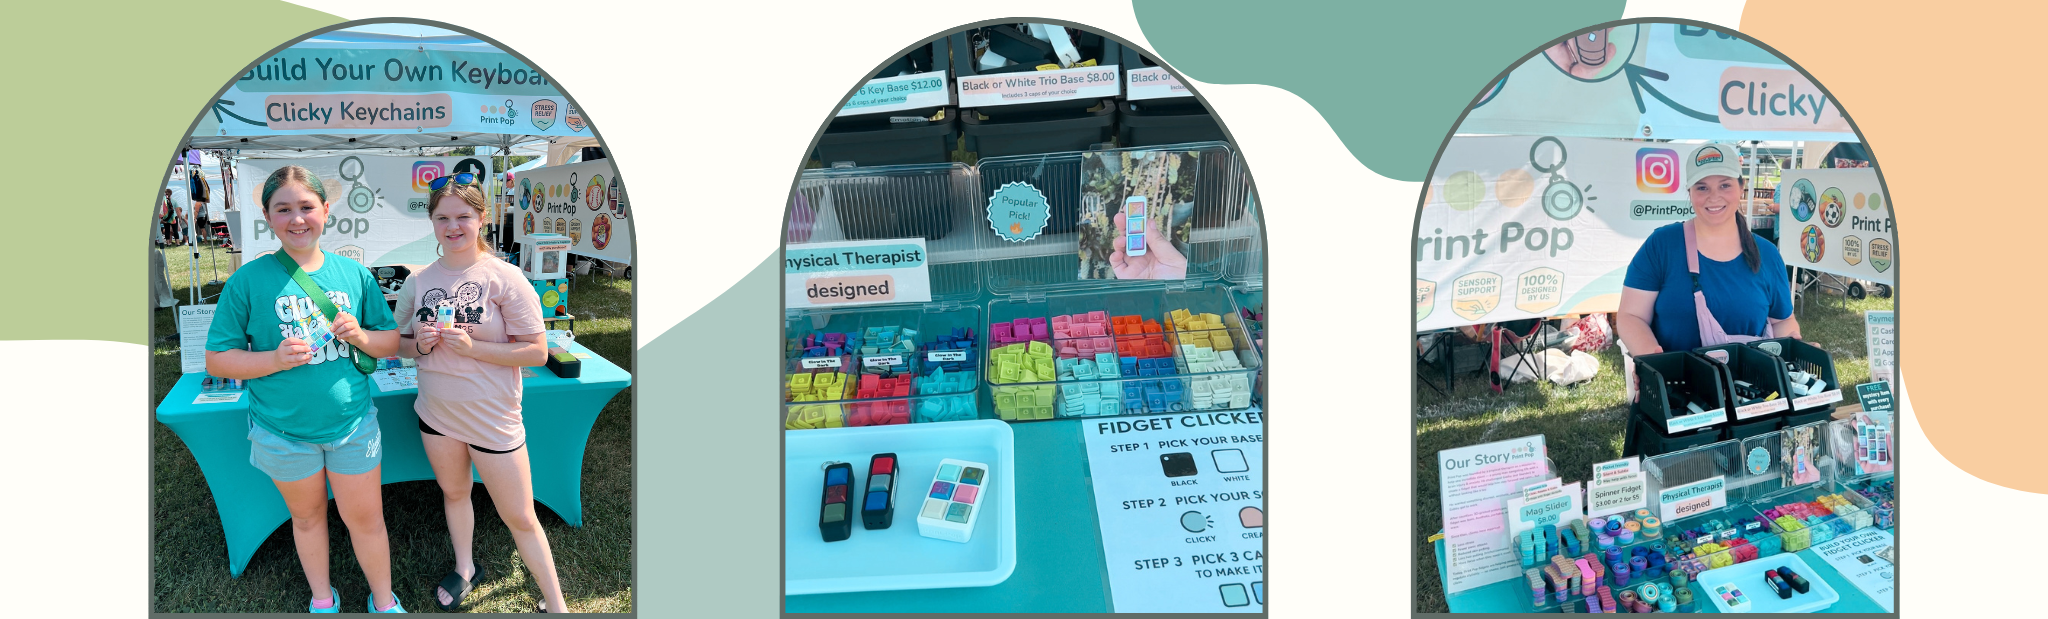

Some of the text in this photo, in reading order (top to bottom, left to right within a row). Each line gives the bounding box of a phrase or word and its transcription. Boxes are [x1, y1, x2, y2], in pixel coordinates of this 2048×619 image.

[315, 57, 376, 81] Your
[384, 58, 443, 82] Own
[962, 71, 1115, 91] Black or White Trio Base $8.00
[1131, 72, 1159, 83] Black
[868, 86, 885, 96] Key
[887, 83, 909, 93] Base
[910, 78, 943, 91] $12.00
[1001, 91, 1024, 99] Includes
[1720, 80, 1827, 124] Clicky
[267, 101, 446, 125] Clicky Keychains
[480, 115, 515, 127] Print Pop
[1002, 195, 1038, 208] Popular
[547, 202, 577, 217] Print Pop
[1009, 210, 1031, 221] Pick!
[322, 214, 370, 239] Pop
[1852, 215, 1881, 232] Print
[1500, 221, 1574, 258] Pop
[1845, 239, 1860, 248] 100%
[337, 250, 361, 258] 100%
[1871, 243, 1889, 251] STRESS
[842, 249, 922, 266] Therapist
[1458, 277, 1497, 288] SENSORY
[1523, 274, 1558, 287] 100%
[807, 280, 890, 300] designed
[1457, 285, 1497, 296] SUPPORT
[1521, 286, 1557, 295] DESIGNED
[196, 308, 216, 316] Story
[1862, 391, 1880, 399] mystery
[1866, 384, 1882, 392] FREE
[1870, 403, 1891, 412] purchase!
[1098, 417, 1174, 435] FIDGET
[1110, 434, 1263, 453] STEP 1 PICK YOUR BASE
[1445, 452, 1510, 470] Our Story
[1524, 452, 1534, 460] Pop
[1170, 479, 1199, 487] BLACK
[1595, 485, 1642, 499] Spinner Fidget
[1662, 481, 1723, 502] Physical Therapist
[1122, 490, 1263, 510] STEP 2 PICK YOUR S
[1595, 499, 1611, 508] $3.00
[1632, 493, 1640, 501] $5
[1676, 499, 1711, 514] designed
[1526, 501, 1568, 518] Mag Slider
[1537, 514, 1557, 525] $8.00
[1185, 535, 1216, 544] CLICKY
[1819, 530, 1878, 551] BUILD YOUR OWN
[1823, 535, 1886, 557] FIDGET CLICKER
[1134, 557, 1169, 570] STEP
[1174, 556, 1183, 567] 3
[1192, 552, 1227, 565] PICK
[1230, 551, 1239, 562] 3
[1195, 569, 1213, 579] TO
[1215, 566, 1251, 577] MAKE
